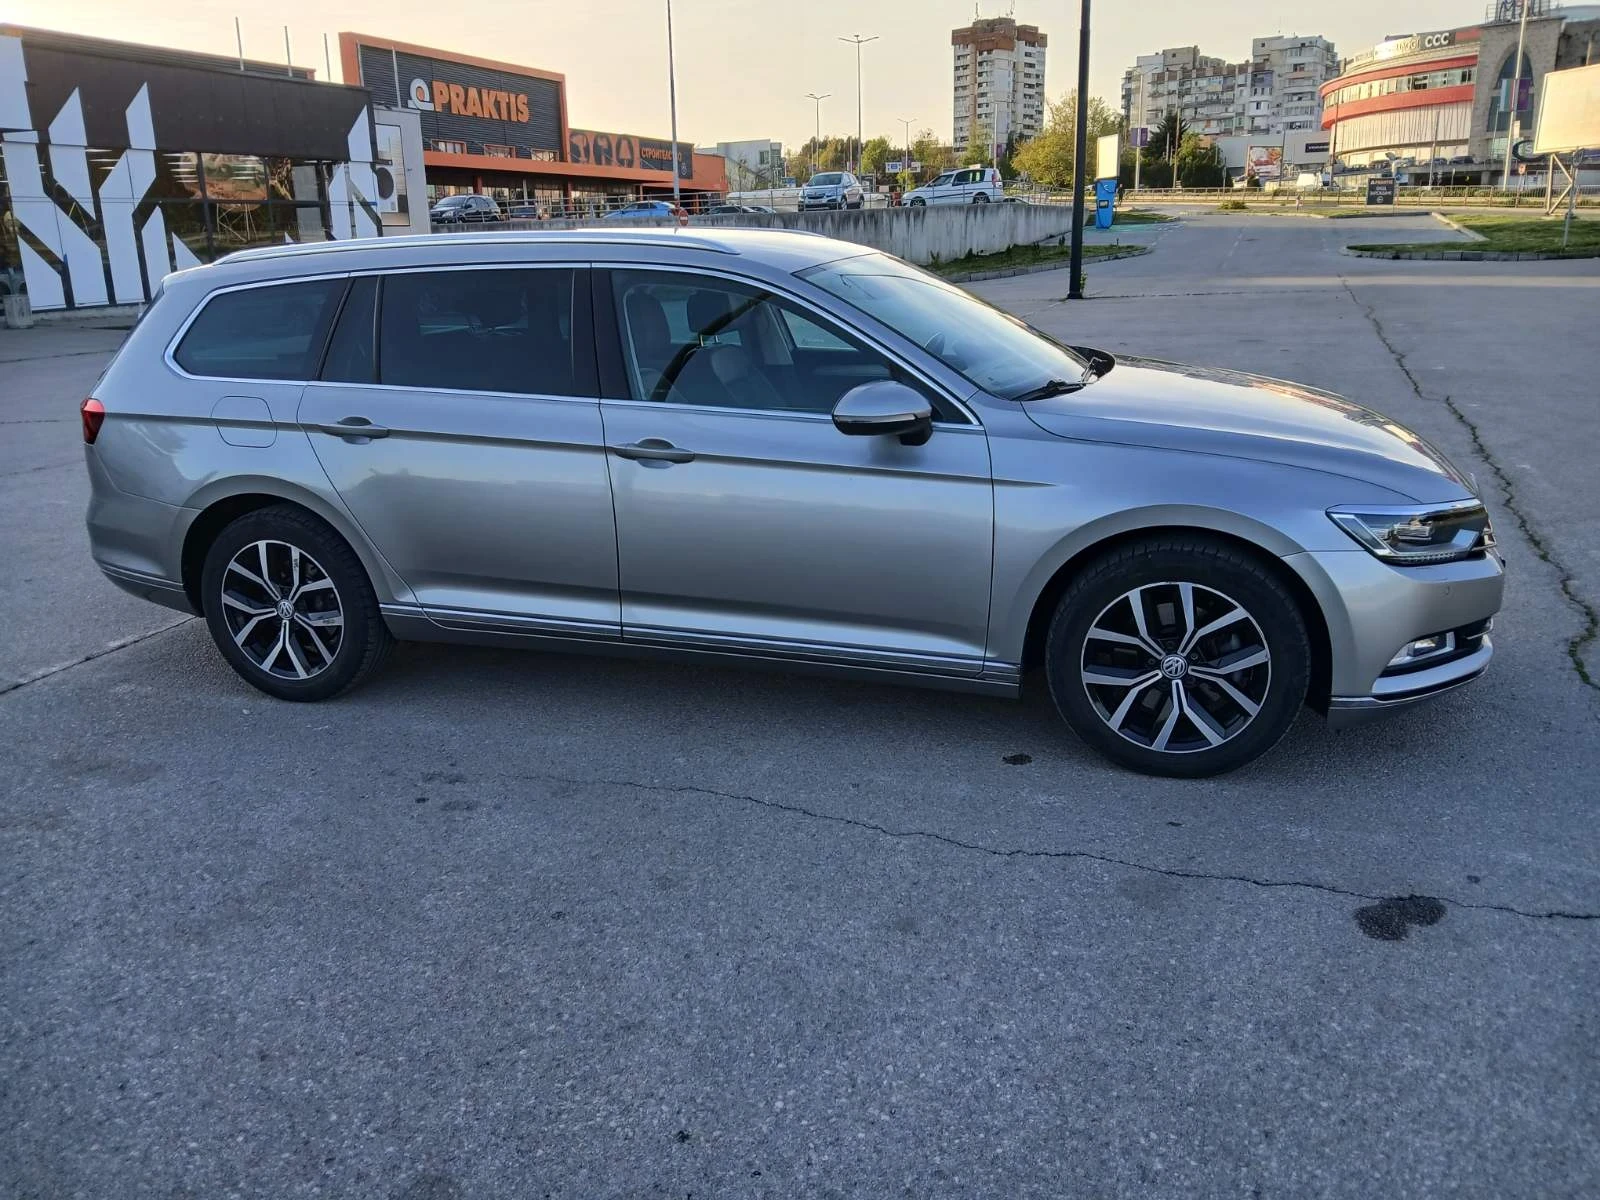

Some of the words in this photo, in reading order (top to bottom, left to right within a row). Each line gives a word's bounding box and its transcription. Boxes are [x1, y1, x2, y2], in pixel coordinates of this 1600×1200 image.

[1424, 32, 1450, 48] CCC
[432, 80, 529, 123] PRAKTIS
[641, 147, 682, 162] СТРОИТЕЛСО
